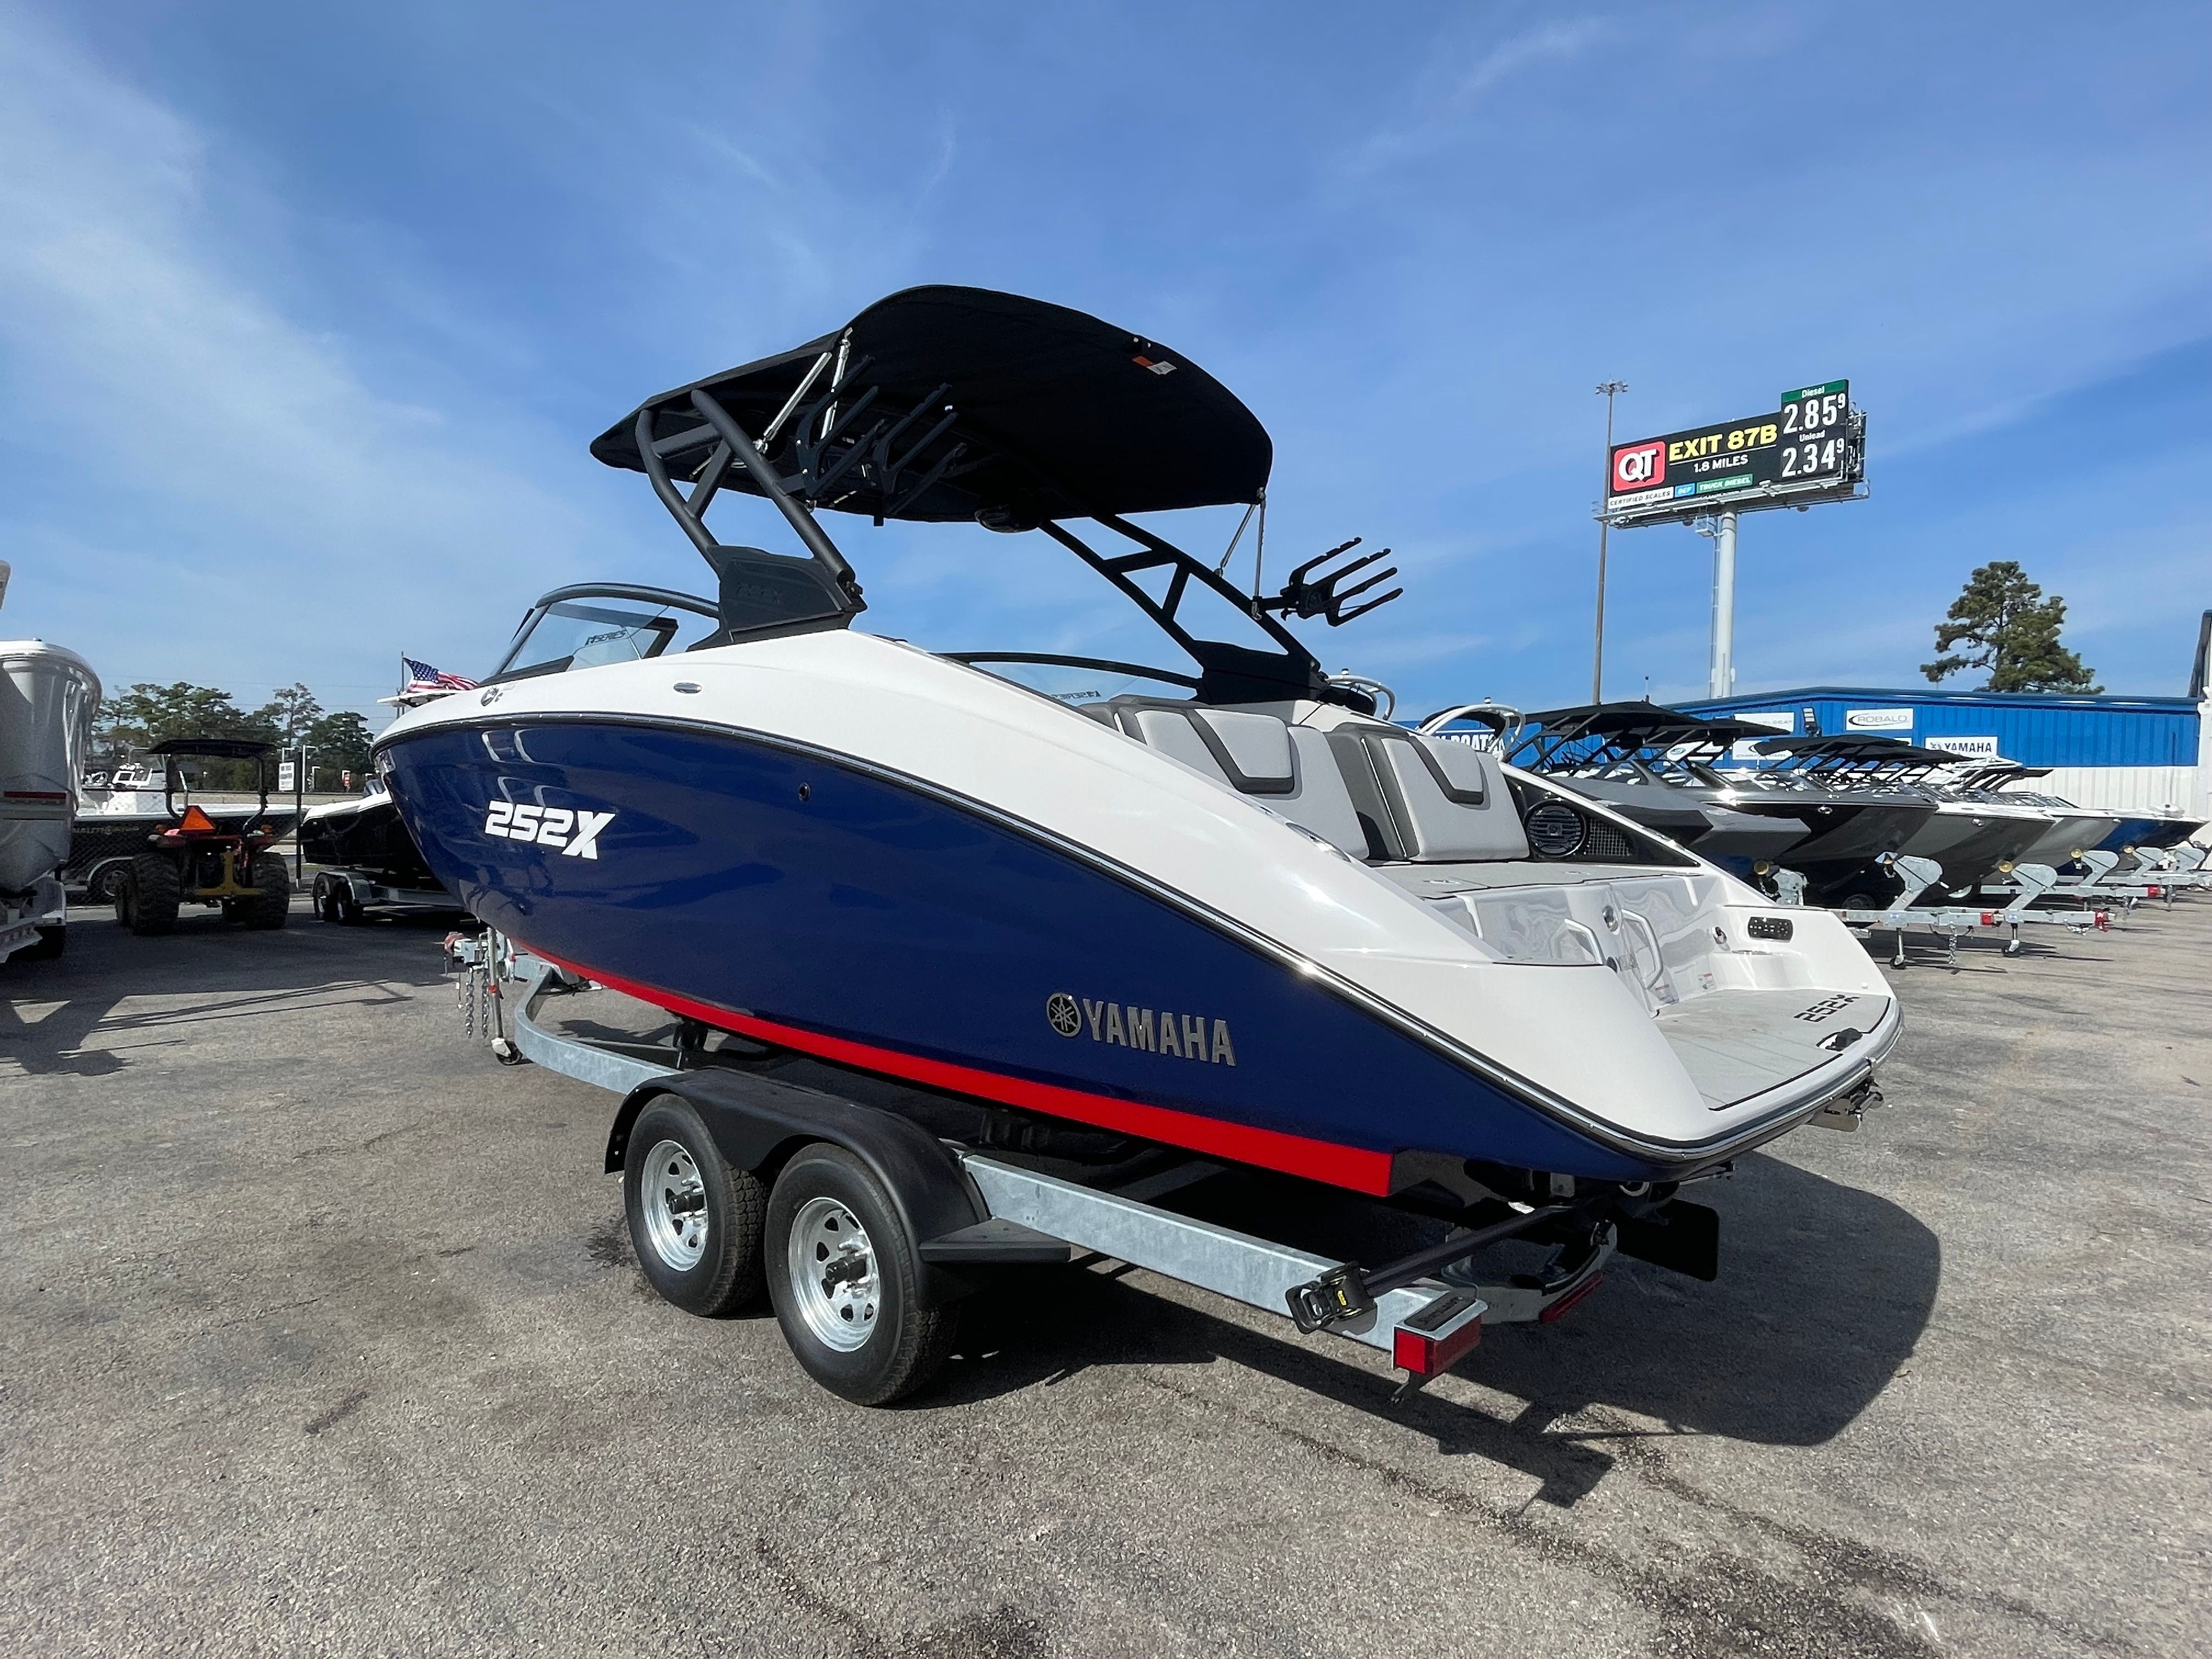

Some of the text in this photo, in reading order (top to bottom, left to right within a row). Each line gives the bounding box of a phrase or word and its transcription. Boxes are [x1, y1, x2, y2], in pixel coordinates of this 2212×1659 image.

[1802, 386, 1825, 398] Diesel
[1669, 424, 1778, 462] EXIT 87B
[1799, 430, 1826, 442] Unlead
[1618, 449, 1657, 482] QT
[1694, 454, 1748, 473] 1.8 MILES
[1700, 477, 1751, 491] TRUCK DIESEL
[1610, 491, 1671, 506] CERTIFIED SCALES
[1945, 742, 1992, 753] YAMAHA
[485, 800, 616, 860] 252X
[1793, 994, 1860, 1022] 252X
[1082, 998, 1237, 1066] YAMAHA
